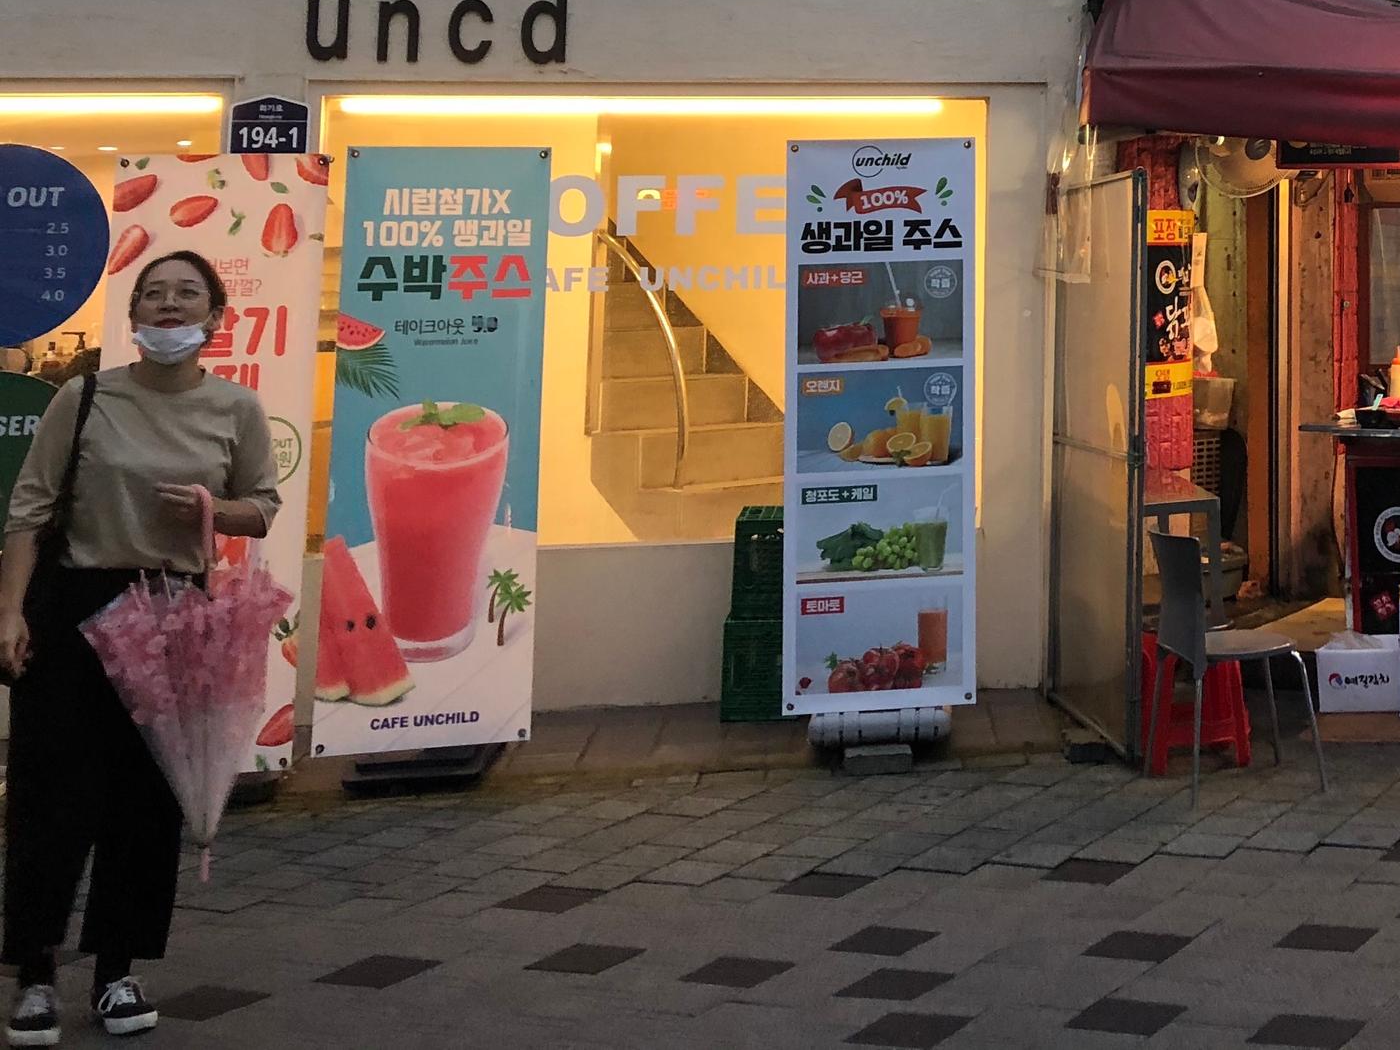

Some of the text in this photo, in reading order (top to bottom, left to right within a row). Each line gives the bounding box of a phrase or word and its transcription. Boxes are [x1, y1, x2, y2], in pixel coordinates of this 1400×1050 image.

[239, 126, 299, 149] 194-1
[855, 153, 913, 168] unchild
[7, 186, 66, 208] OUT
[860, 189, 909, 210] 100%
[46, 222, 70, 235] 2.5
[363, 219, 532, 248] 100% 생과일
[800, 218, 963, 254] 생과일 주스
[1153, 218, 1177, 241] 포장
[45, 245, 69, 257] 3.0
[43, 267, 66, 280] 3.5
[357, 254, 532, 302] 수박주스
[394, 318, 465, 336] 테이크아웃
[806, 379, 840, 393] 오렌지
[806, 599, 841, 613] 토마토
[370, 711, 480, 731] CAFE UNCHILD
